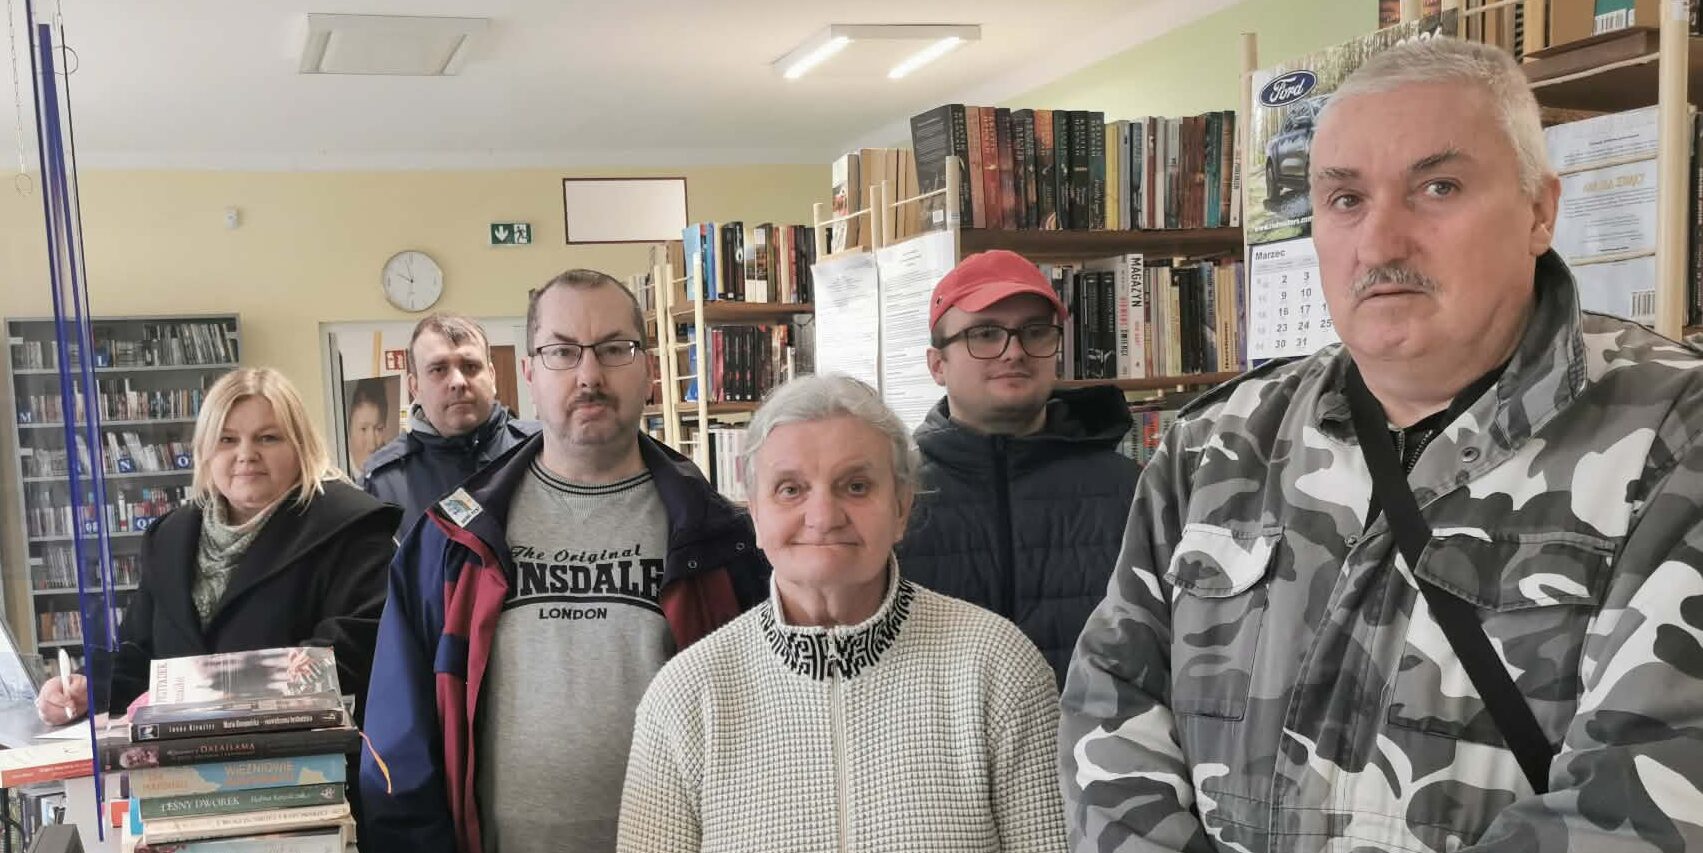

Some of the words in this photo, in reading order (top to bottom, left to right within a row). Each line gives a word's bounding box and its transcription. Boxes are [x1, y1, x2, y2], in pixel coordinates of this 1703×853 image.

[1269, 76, 1305, 103] Ford
[1255, 249, 1286, 261] Marzec
[1281, 274, 1288, 284] 2
[1303, 271, 1310, 281] 3
[1131, 257, 1143, 307] MAGAZYN
[1281, 290, 1287, 300] 9
[1300, 287, 1312, 297] 10
[1300, 304, 1311, 314] 17
[1276, 323, 1288, 333] 23
[1297, 320, 1309, 331] 24
[1320, 318, 1333, 328] 25
[1274, 339, 1286, 349] 30
[1296, 337, 1308, 347] 31
[177, 455, 189, 467] O
[512, 545, 546, 559] The
[554, 544, 642, 564] Original
[512, 558, 665, 599] NSDALE
[538, 607, 608, 620] LONDON
